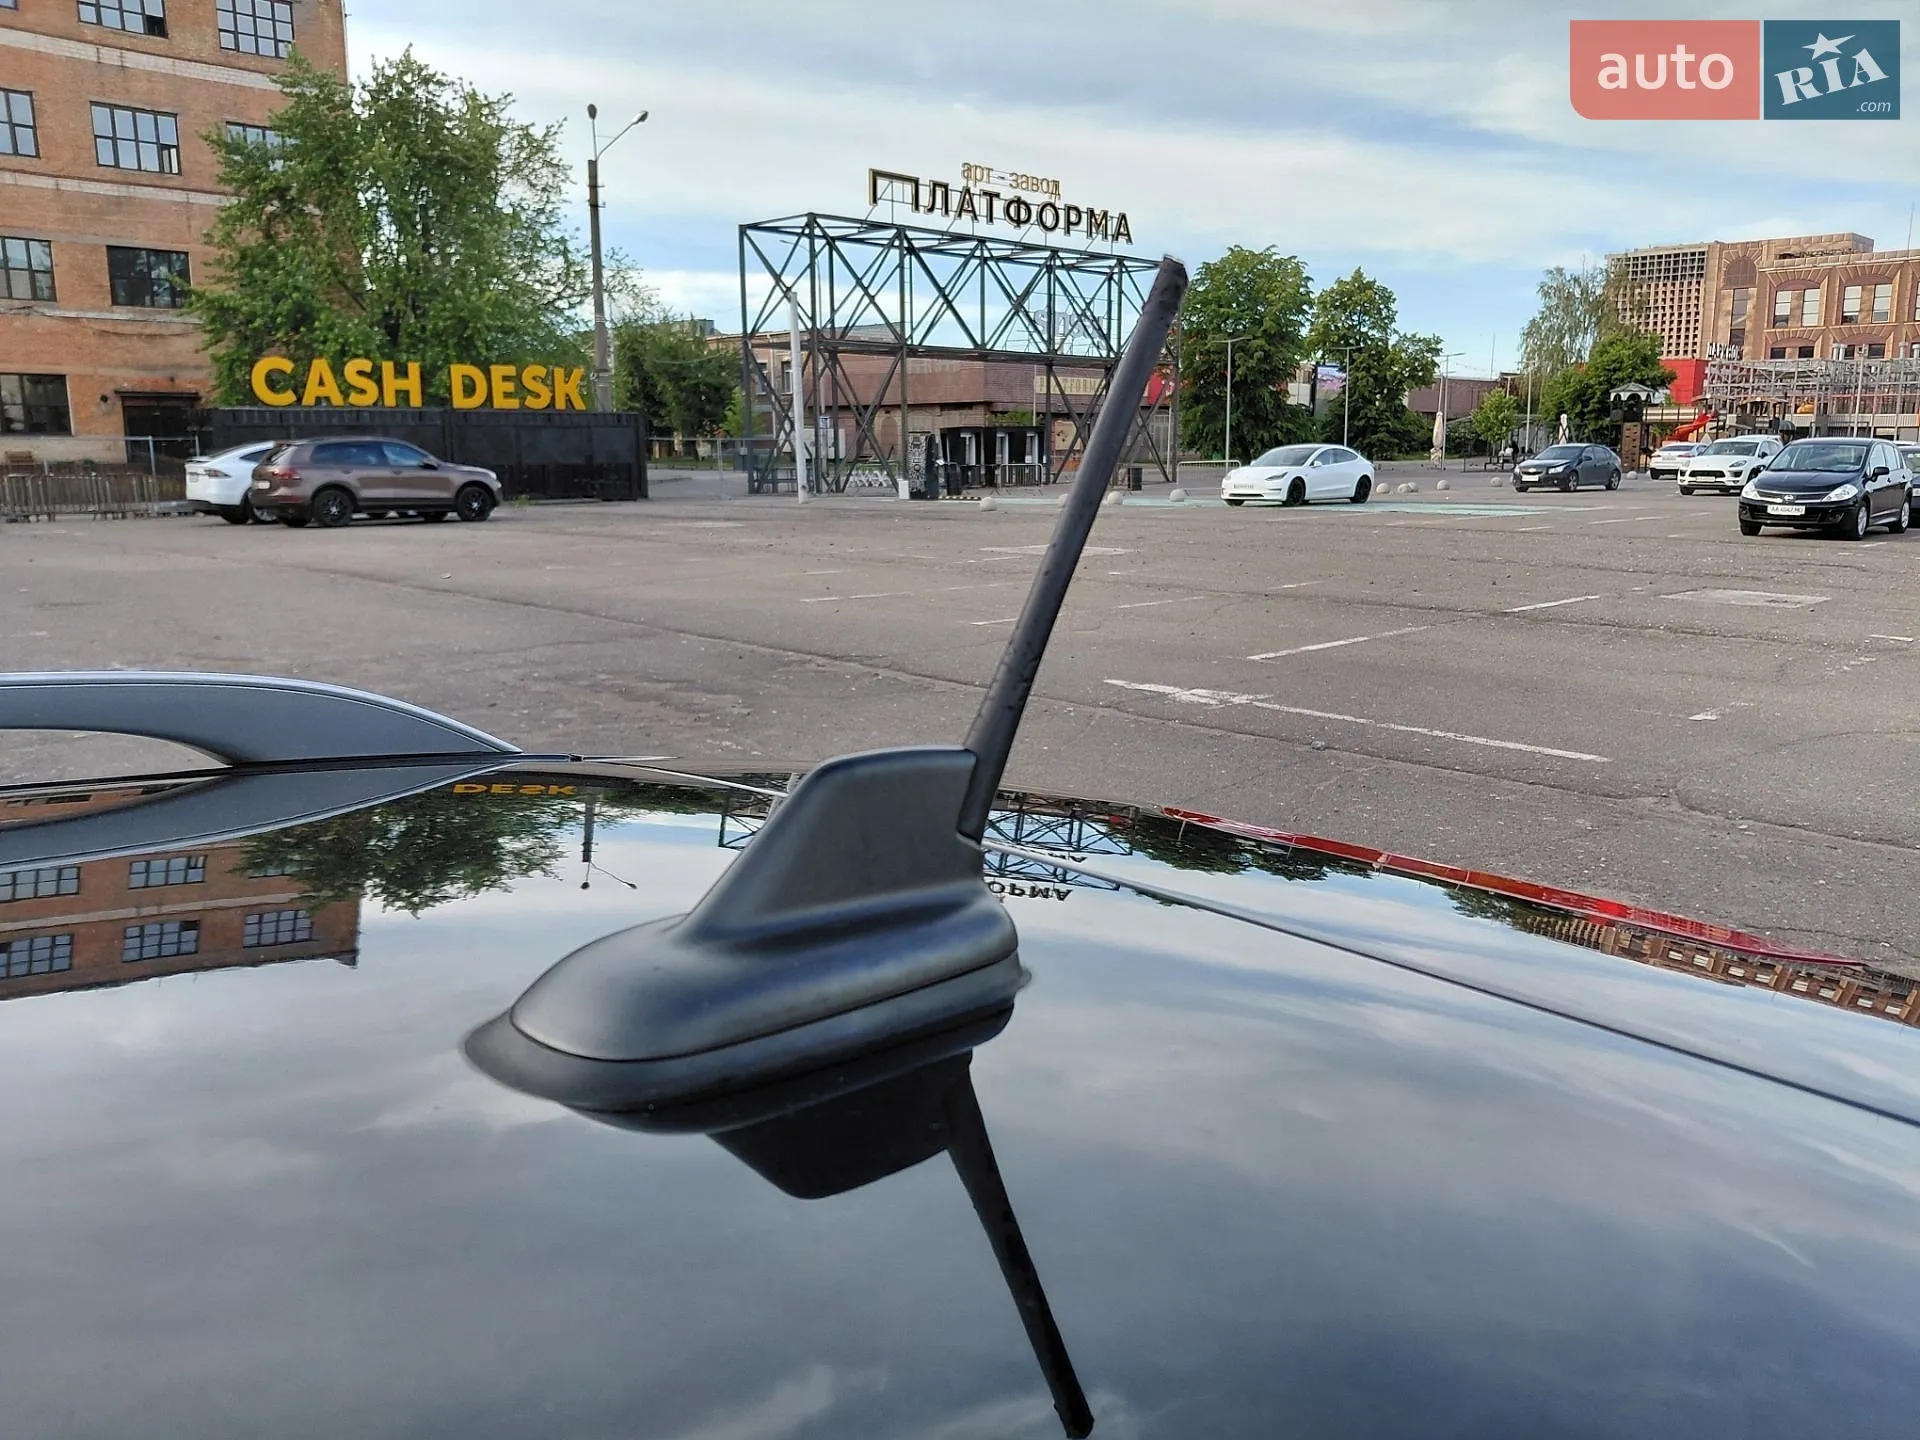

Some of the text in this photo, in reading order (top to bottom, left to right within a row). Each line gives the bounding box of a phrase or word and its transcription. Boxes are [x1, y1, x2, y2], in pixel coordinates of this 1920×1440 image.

[868, 168, 1133, 244] ПЛАТФОРМА
[251, 356, 587, 411] CASH DESK
